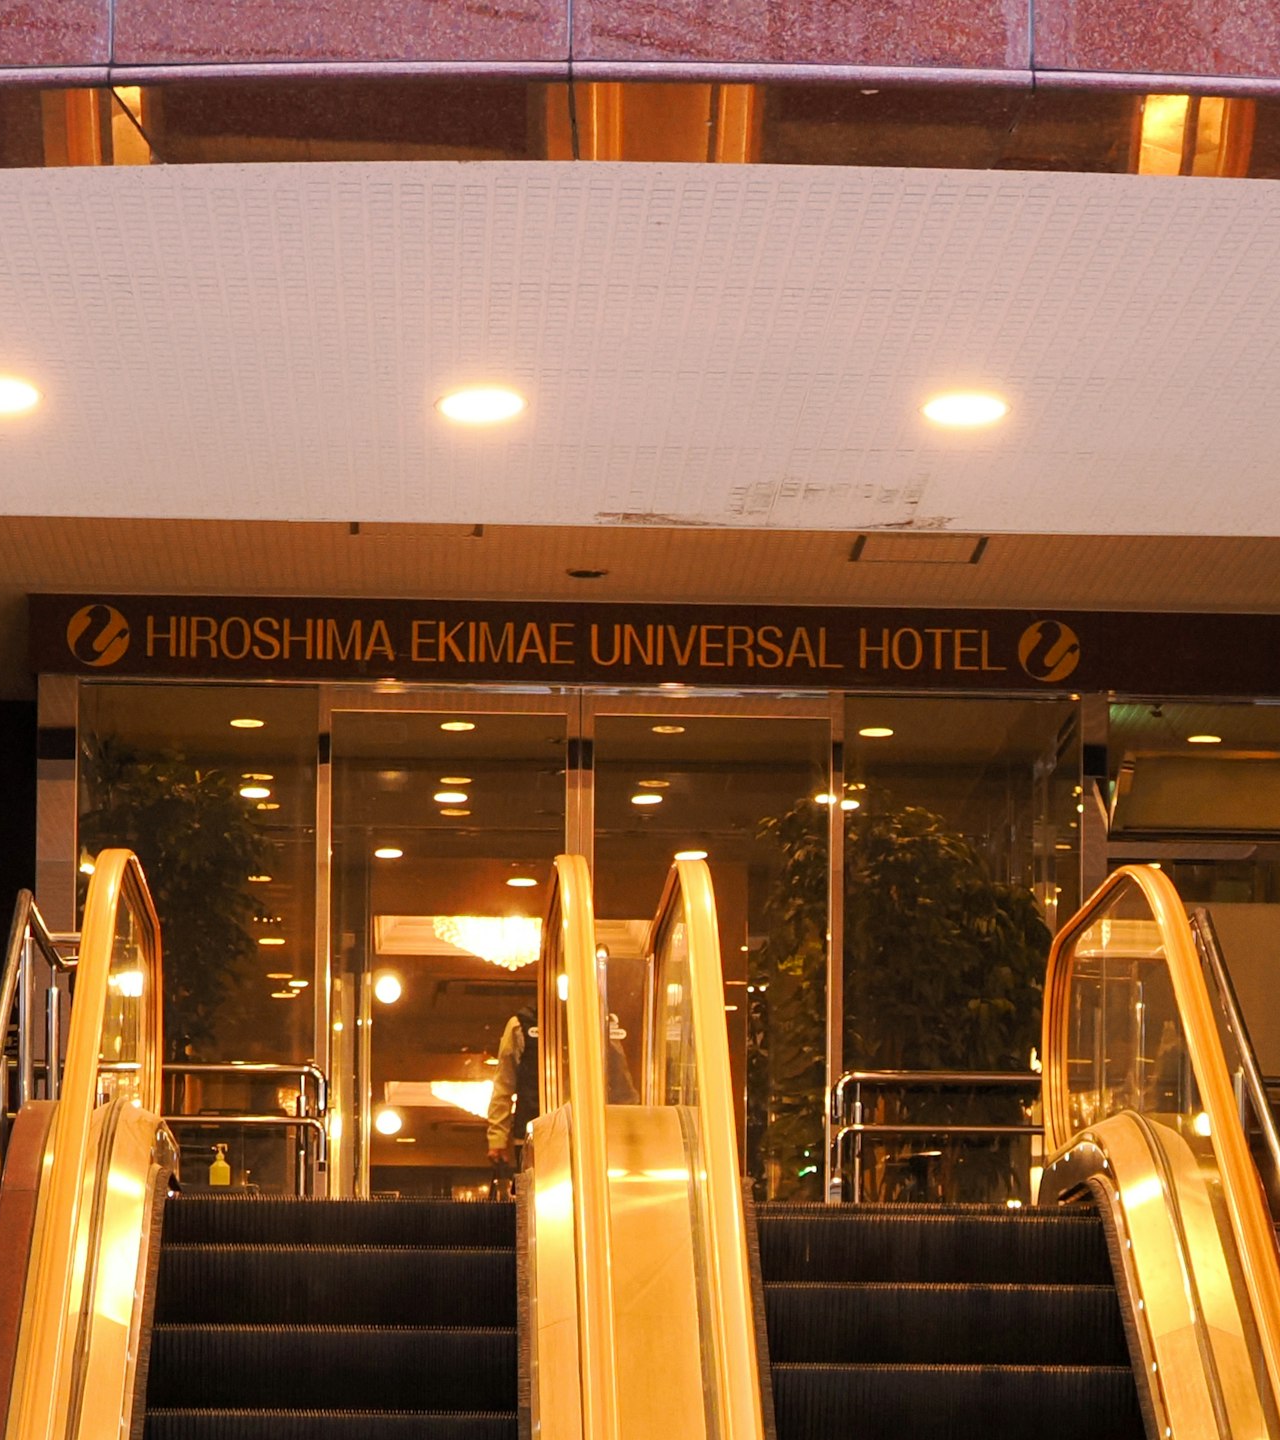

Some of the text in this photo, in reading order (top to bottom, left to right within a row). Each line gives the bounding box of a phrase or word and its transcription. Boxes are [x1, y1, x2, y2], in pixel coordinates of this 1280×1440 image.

[146, 616, 1007, 671] HIROSHIMA EKIMAE UNIVERSAL HOTEL
